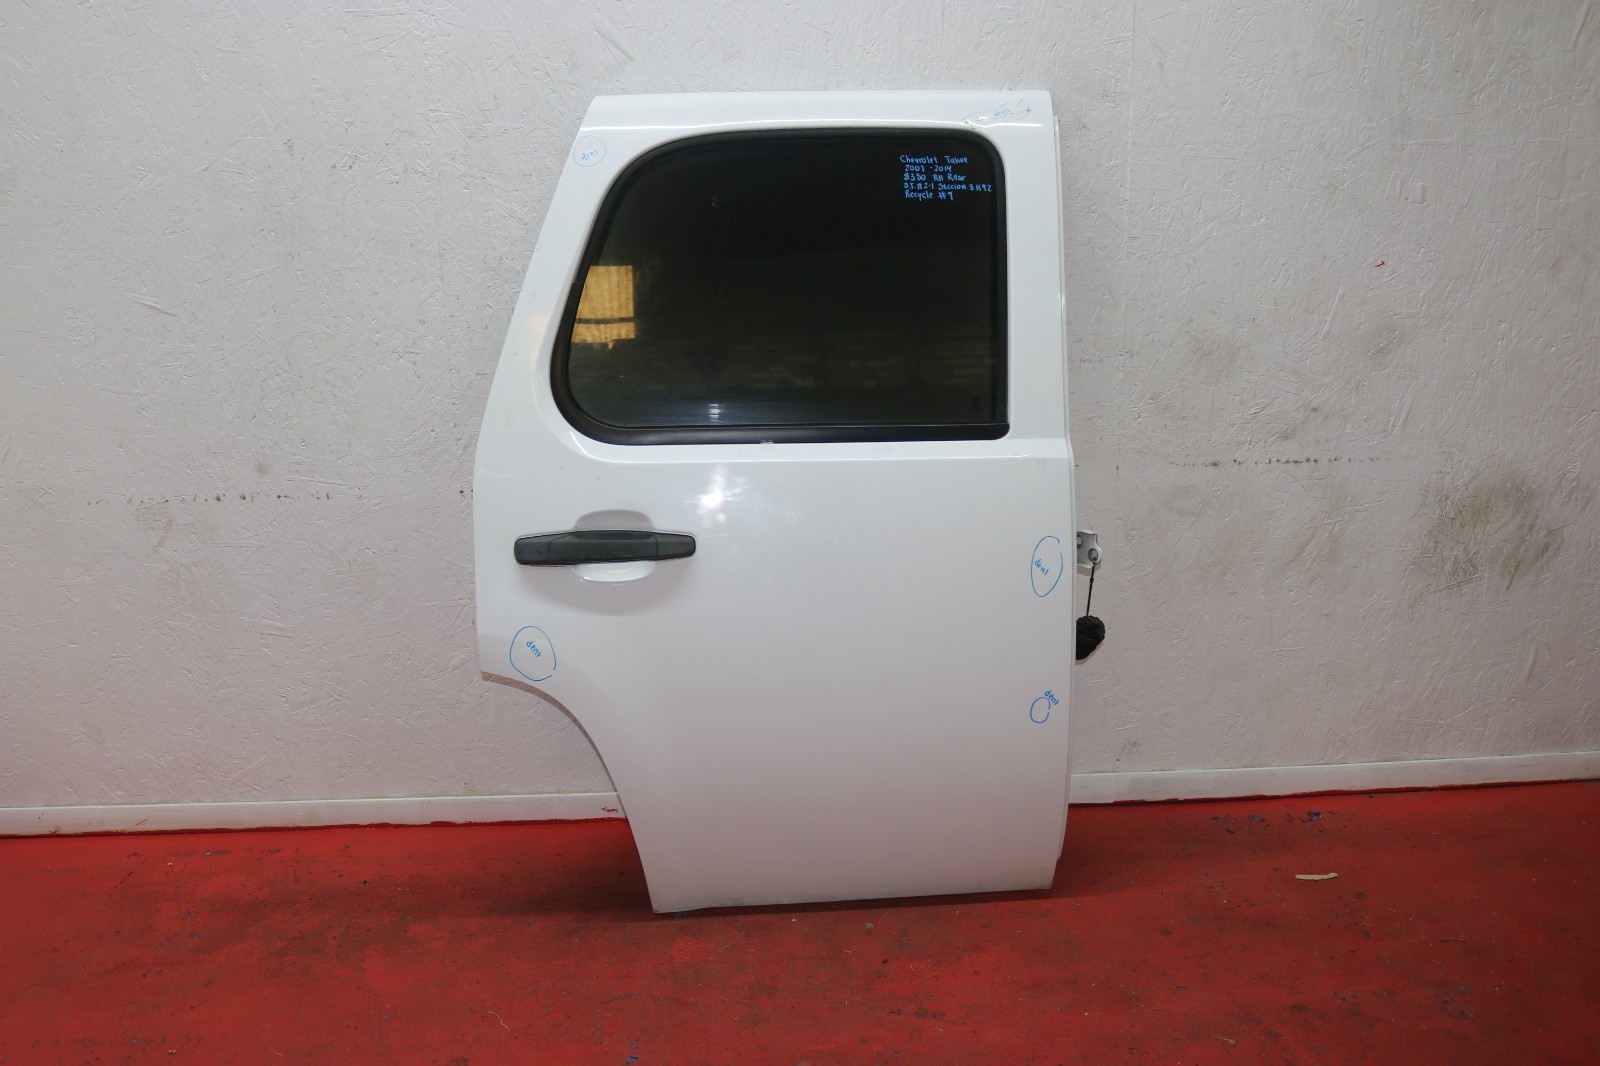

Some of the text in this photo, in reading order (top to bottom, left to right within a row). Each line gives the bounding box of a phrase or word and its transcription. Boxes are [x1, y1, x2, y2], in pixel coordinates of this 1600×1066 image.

[932, 173, 944, 182] RH
[947, 172, 967, 182] Rear
[904, 189, 934, 202] Recycle
[526, 640, 542, 658] dent
[1044, 689, 1060, 706] dent
